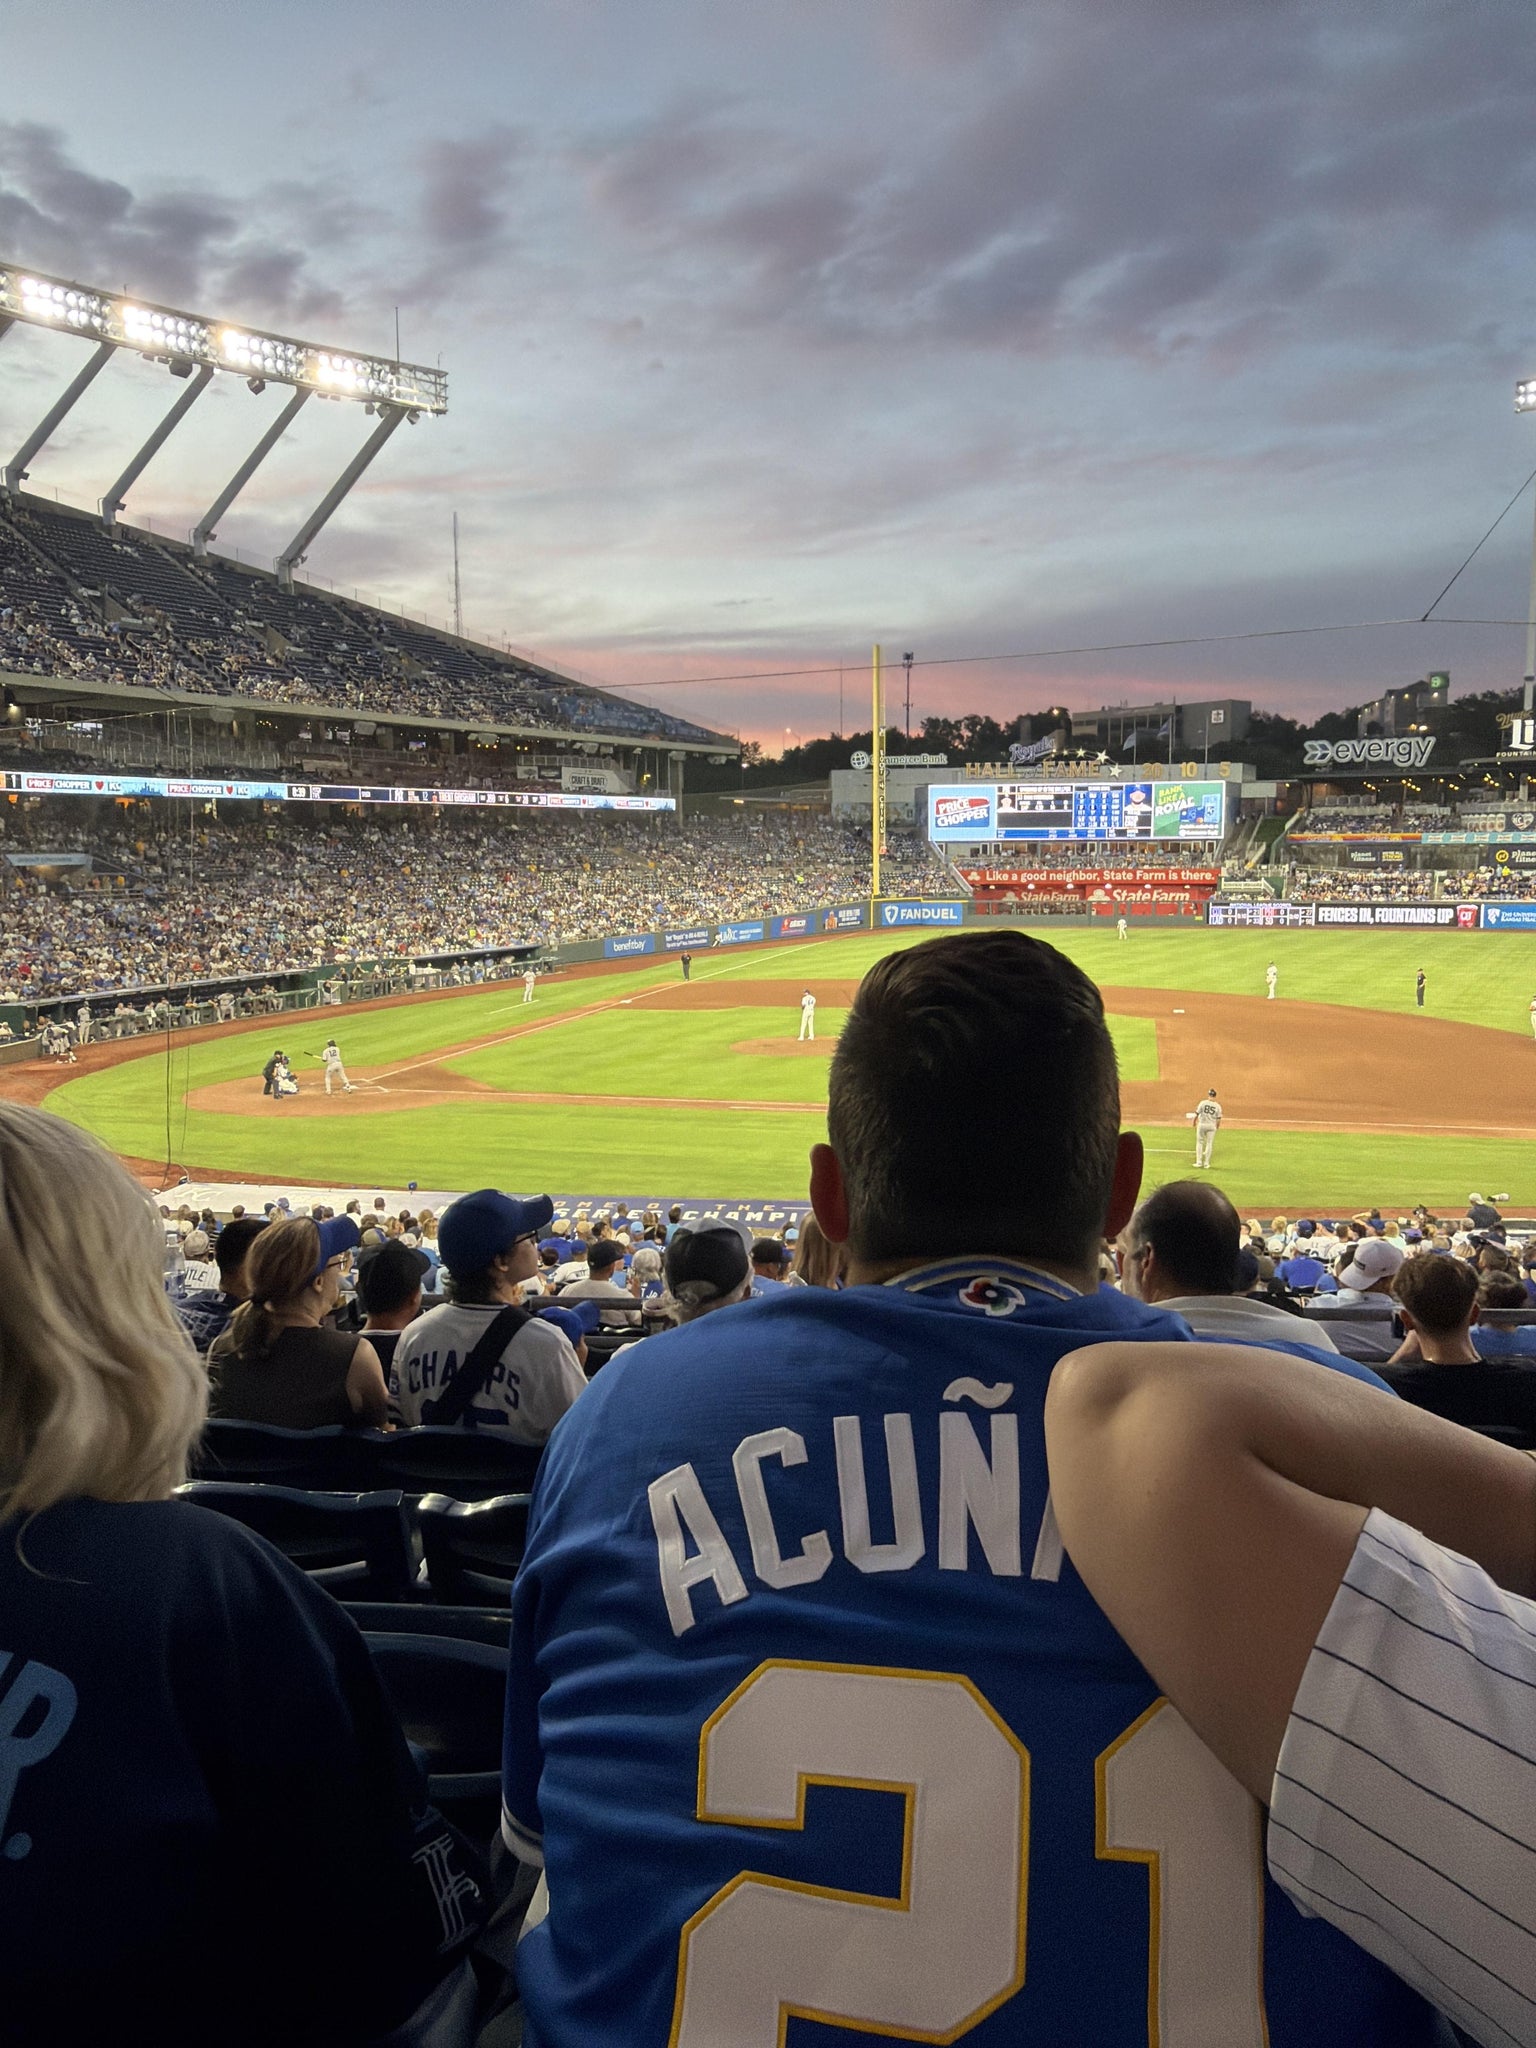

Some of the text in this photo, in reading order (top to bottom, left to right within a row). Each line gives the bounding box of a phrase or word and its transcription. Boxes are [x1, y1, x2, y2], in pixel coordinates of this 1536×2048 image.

[921, 753, 948, 765] Bank
[1334, 737, 1436, 767] evergy
[966, 762, 1014, 779] HALL
[1043, 760, 1101, 778] FAME
[1180, 762, 1198, 777] 10
[1219, 762, 1231, 776] 5
[28, 779, 52, 788] PRICE
[1159, 785, 1183, 797] BANK
[938, 799, 970, 814] PRICE
[1155, 796, 1195, 816] ROYAL
[937, 810, 989, 827] CHOPPER
[986, 870, 1215, 882] Like a good neighbor, State Farm is there.
[1112, 889, 1190, 901] State Farm
[900, 908, 958, 920] FANDUEL
[1318, 907, 1355, 922] FENCES
[1375, 908, 1434, 923] FOUNTAINS
[1436, 909, 1453, 923] UP
[613, 939, 647, 952] benefitbay
[328, 1049, 337, 1057] 12
[1203, 1104, 1216, 1115] 85
[408, 1349, 521, 1411] CHAPS
[668, 1658, 1272, 2048] 21
